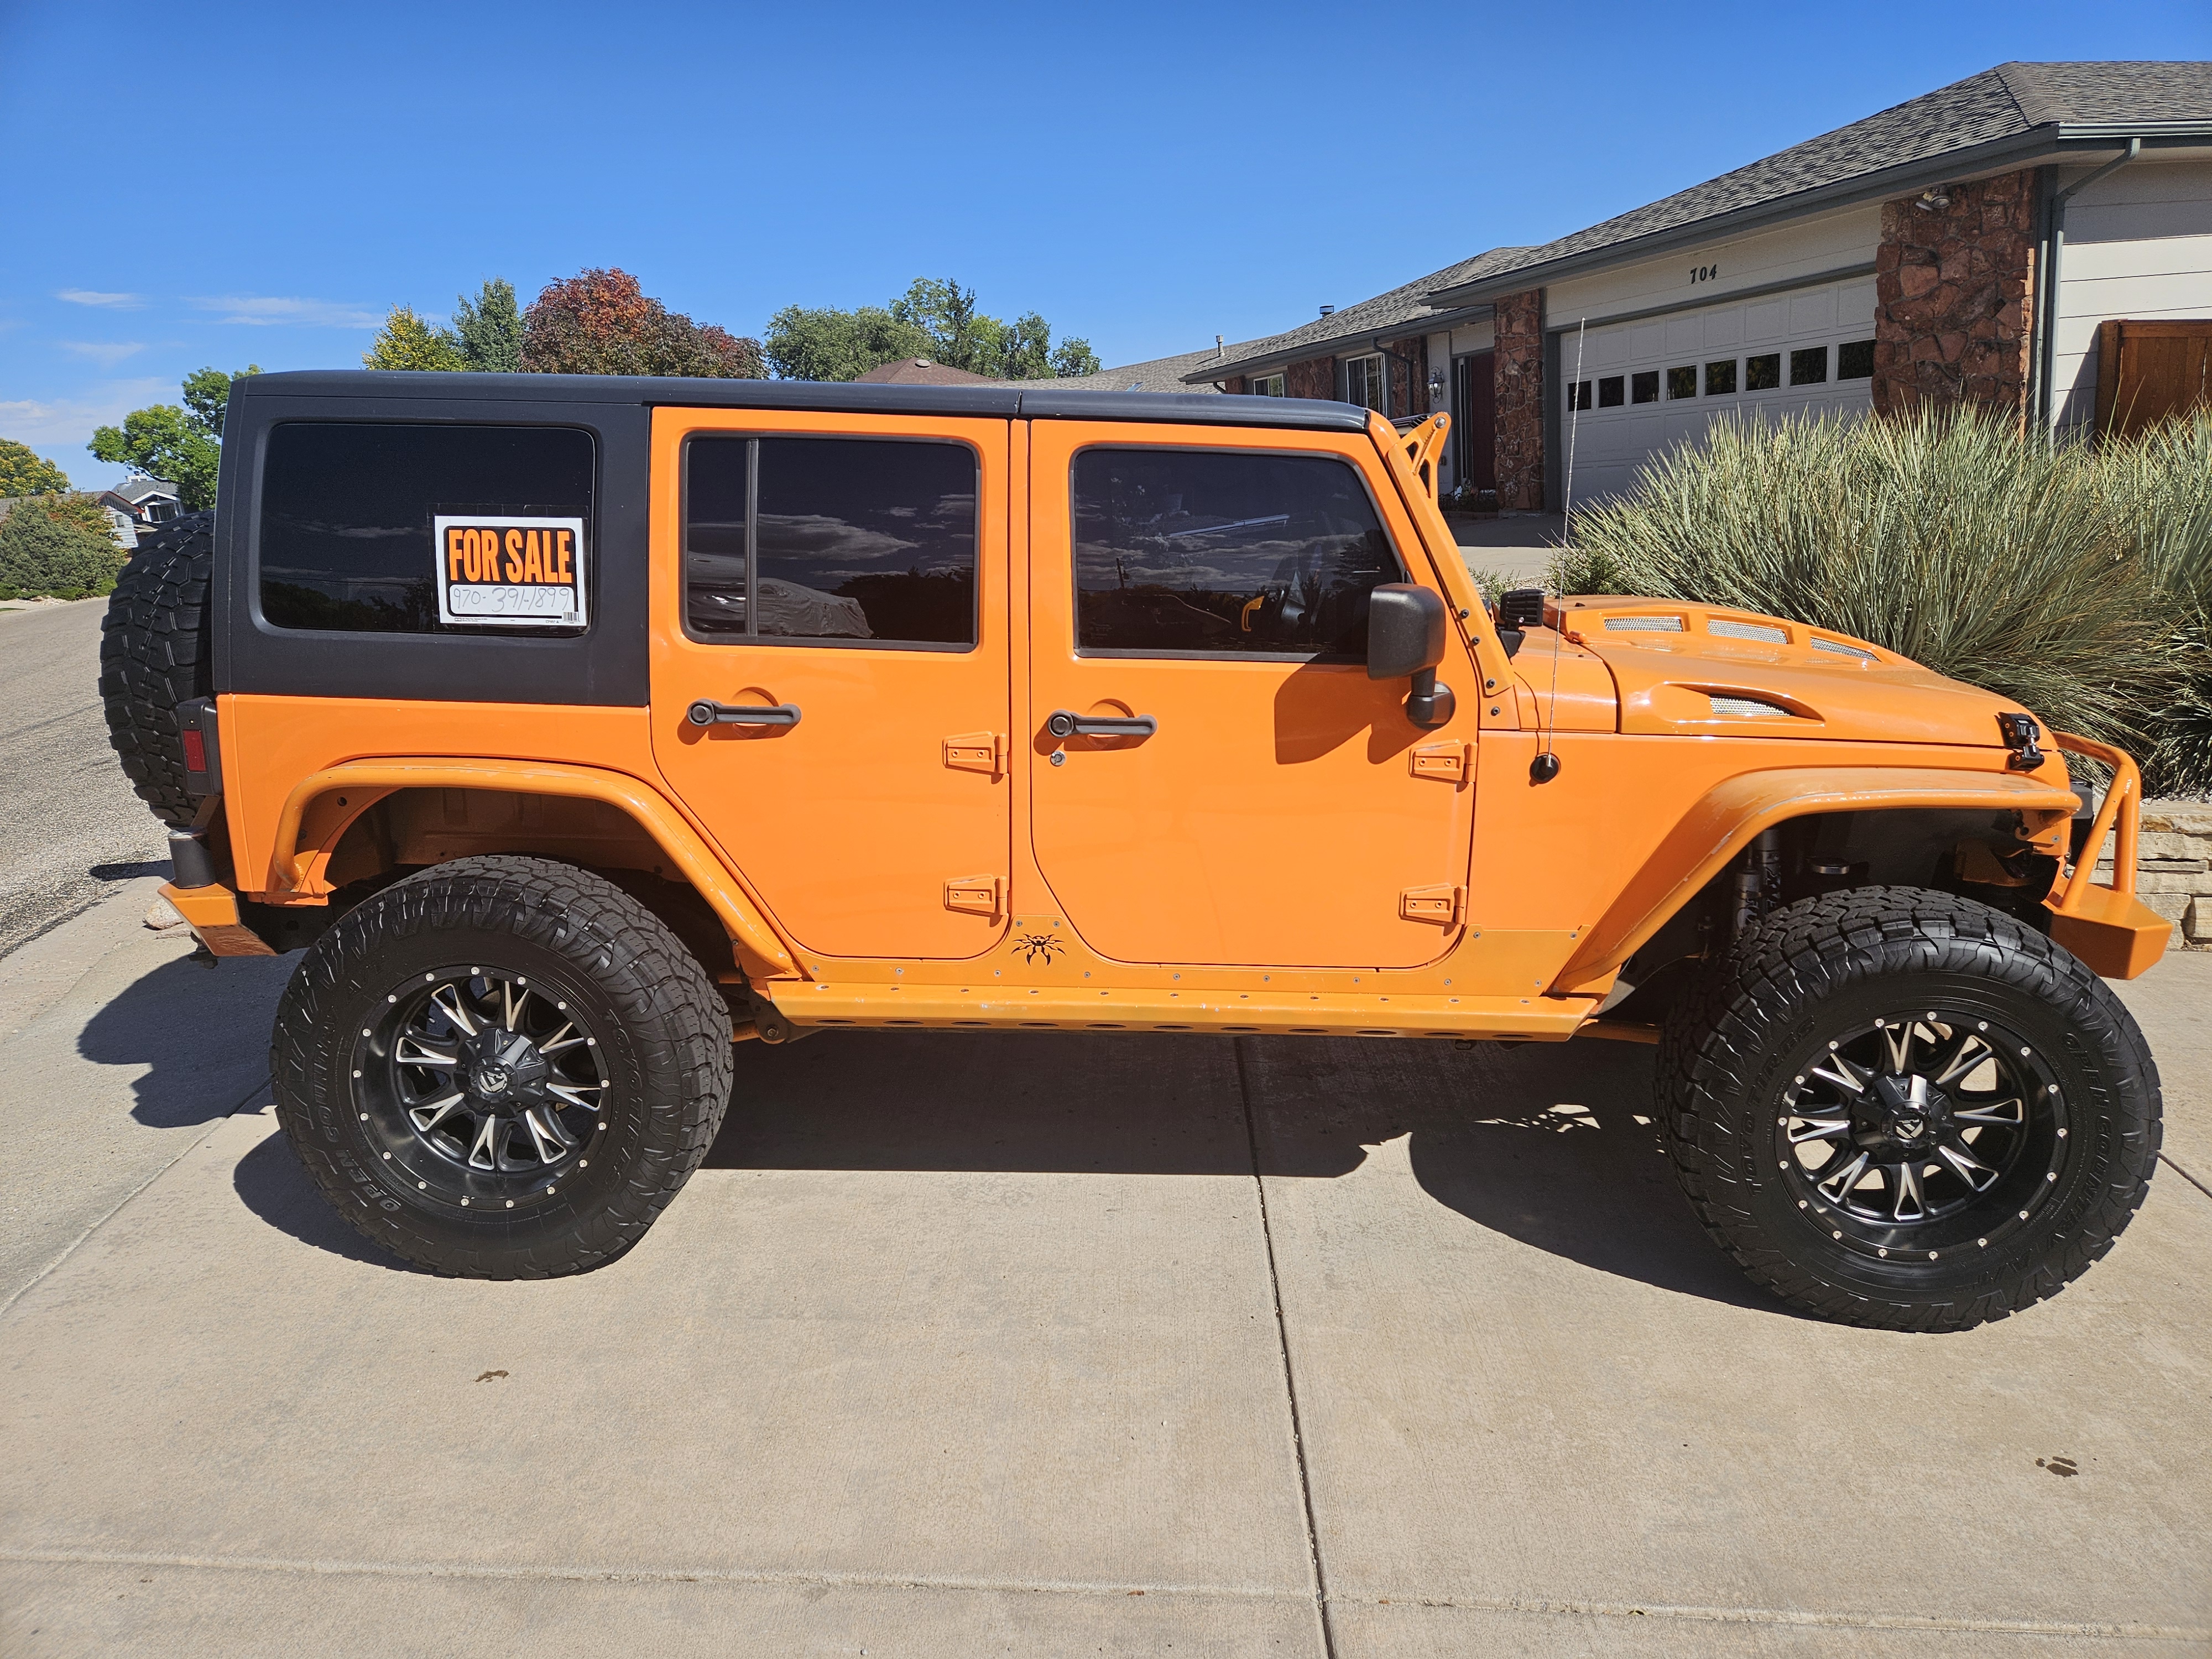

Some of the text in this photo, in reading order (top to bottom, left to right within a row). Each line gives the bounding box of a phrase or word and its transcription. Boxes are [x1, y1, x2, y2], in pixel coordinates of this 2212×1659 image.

[1690, 264, 1717, 284] 704
[448, 529, 572, 583] FOR SALE
[335, 1149, 402, 1212] OPEN
